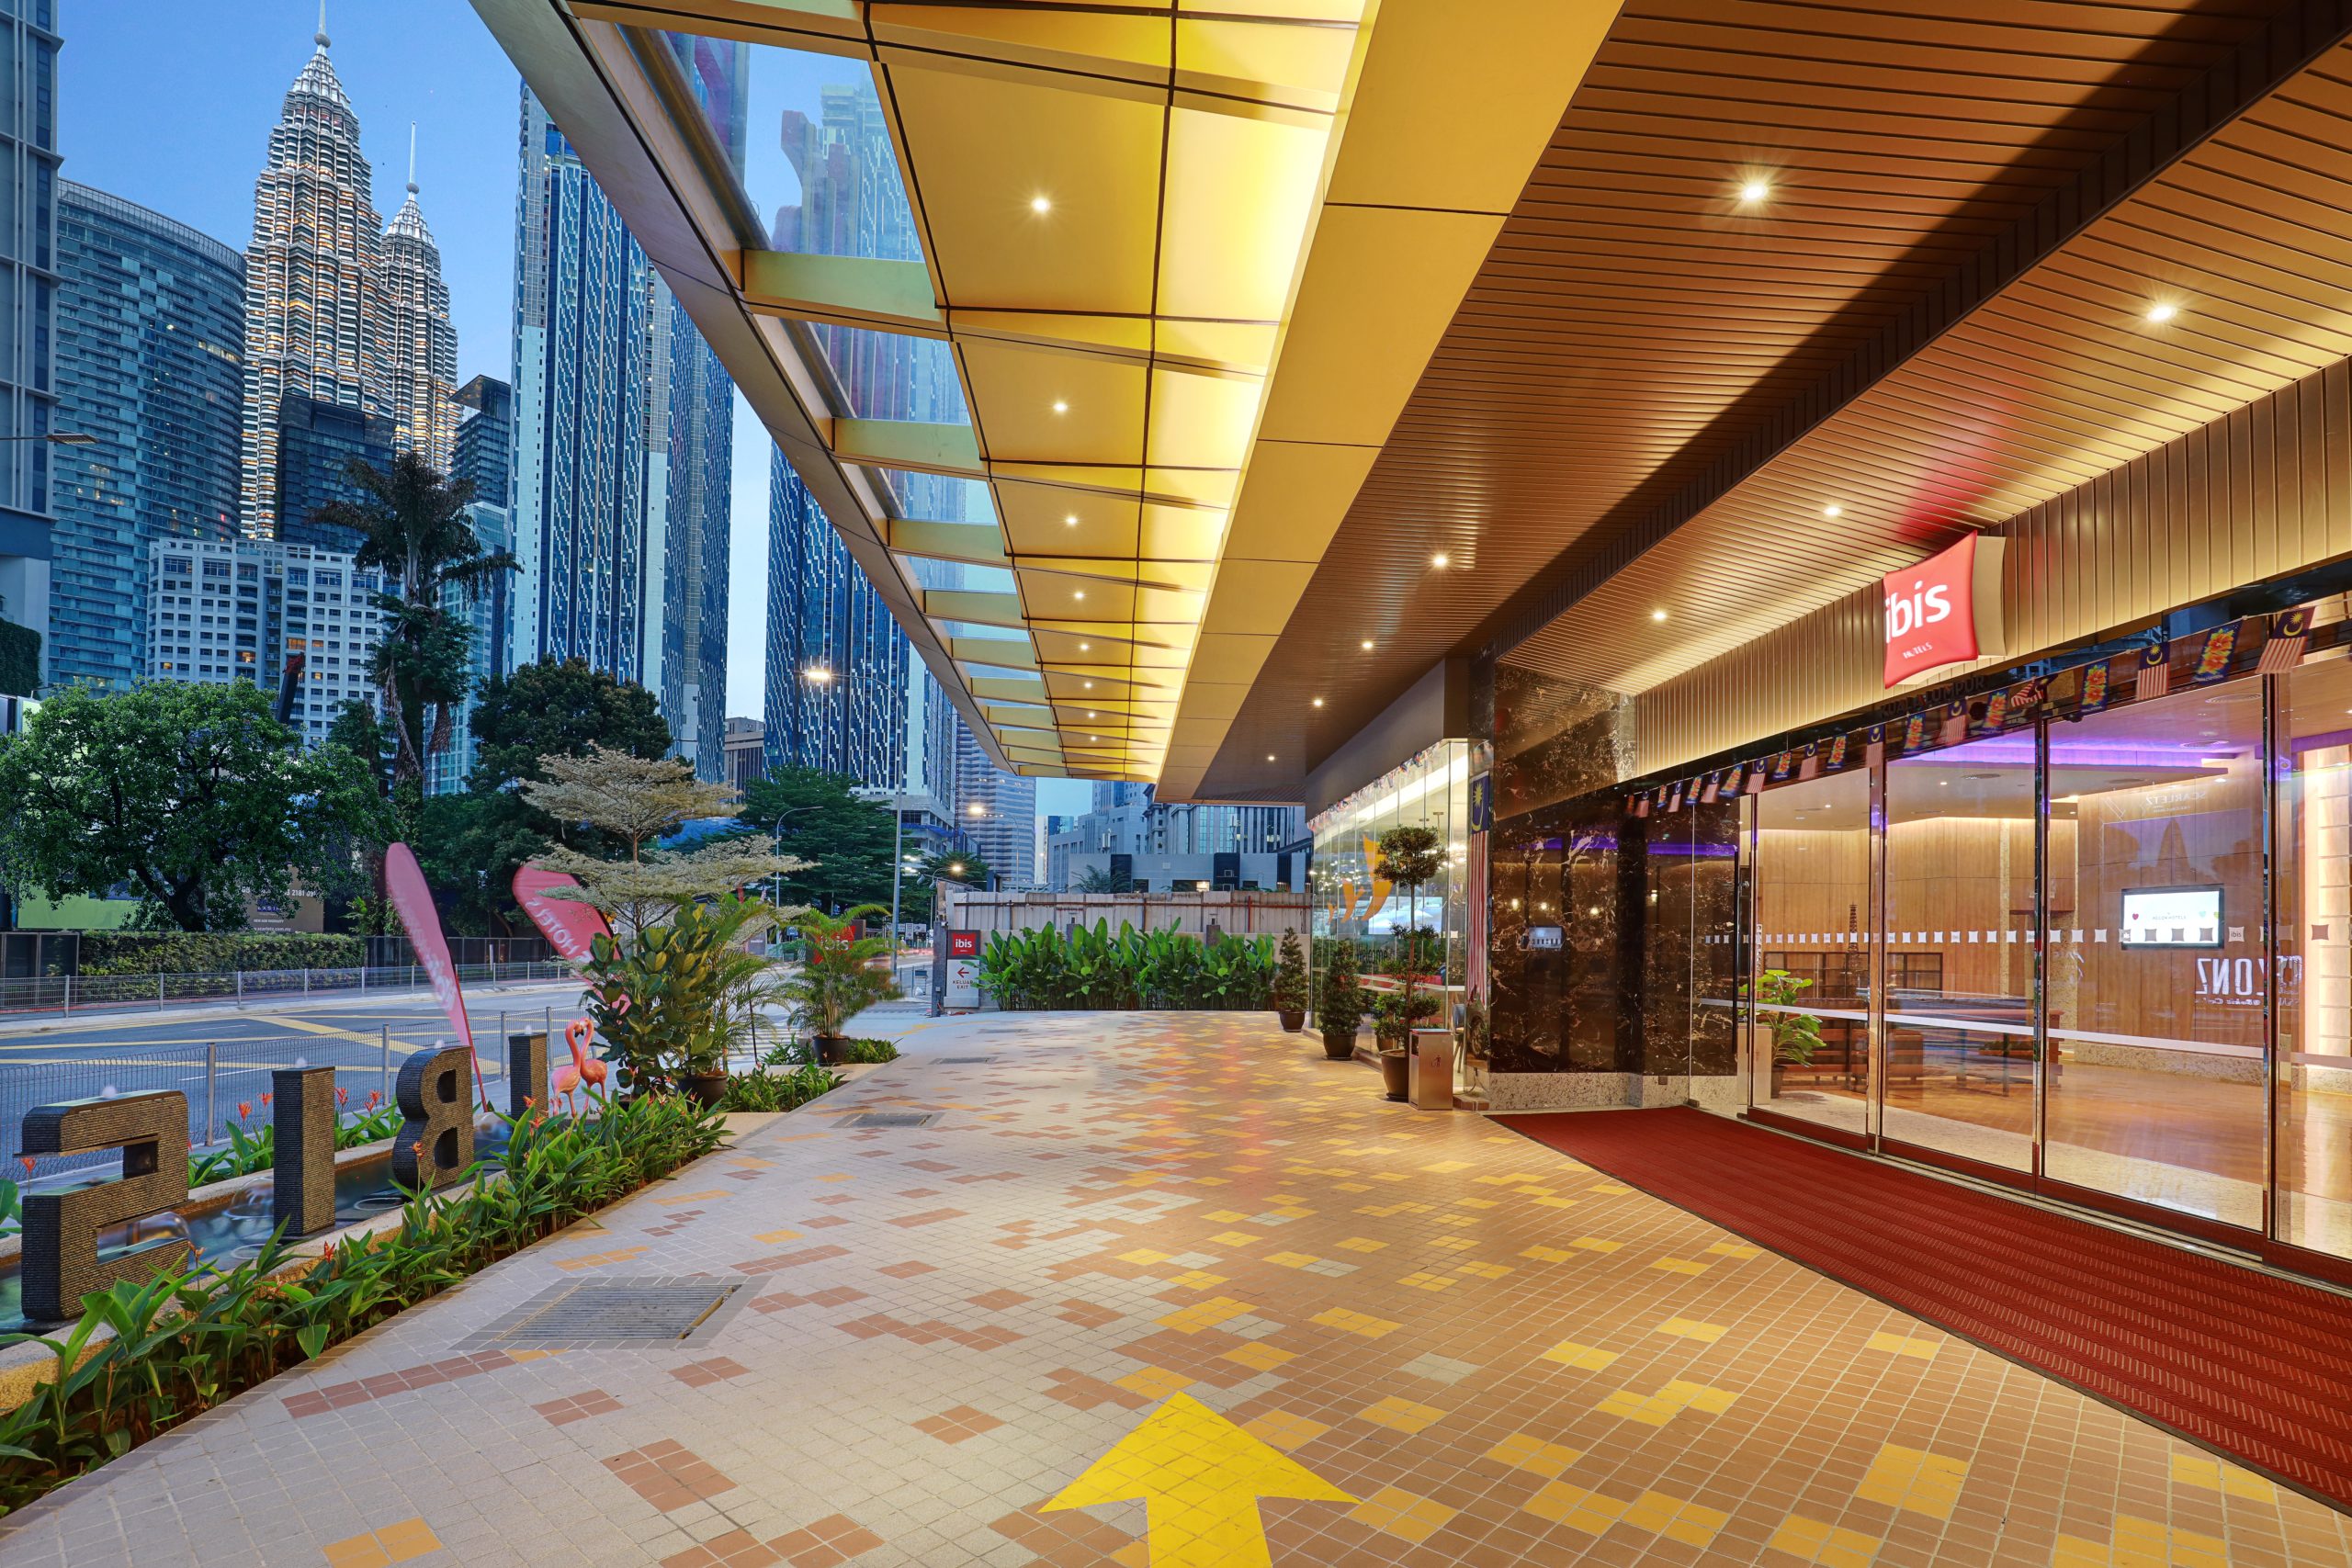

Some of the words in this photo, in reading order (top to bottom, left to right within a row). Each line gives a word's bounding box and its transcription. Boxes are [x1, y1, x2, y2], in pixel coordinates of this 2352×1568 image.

[1885, 581, 1951, 643] ibis
[1926, 676, 1984, 705] LUMPUR
[956, 939, 972, 948] ibis
